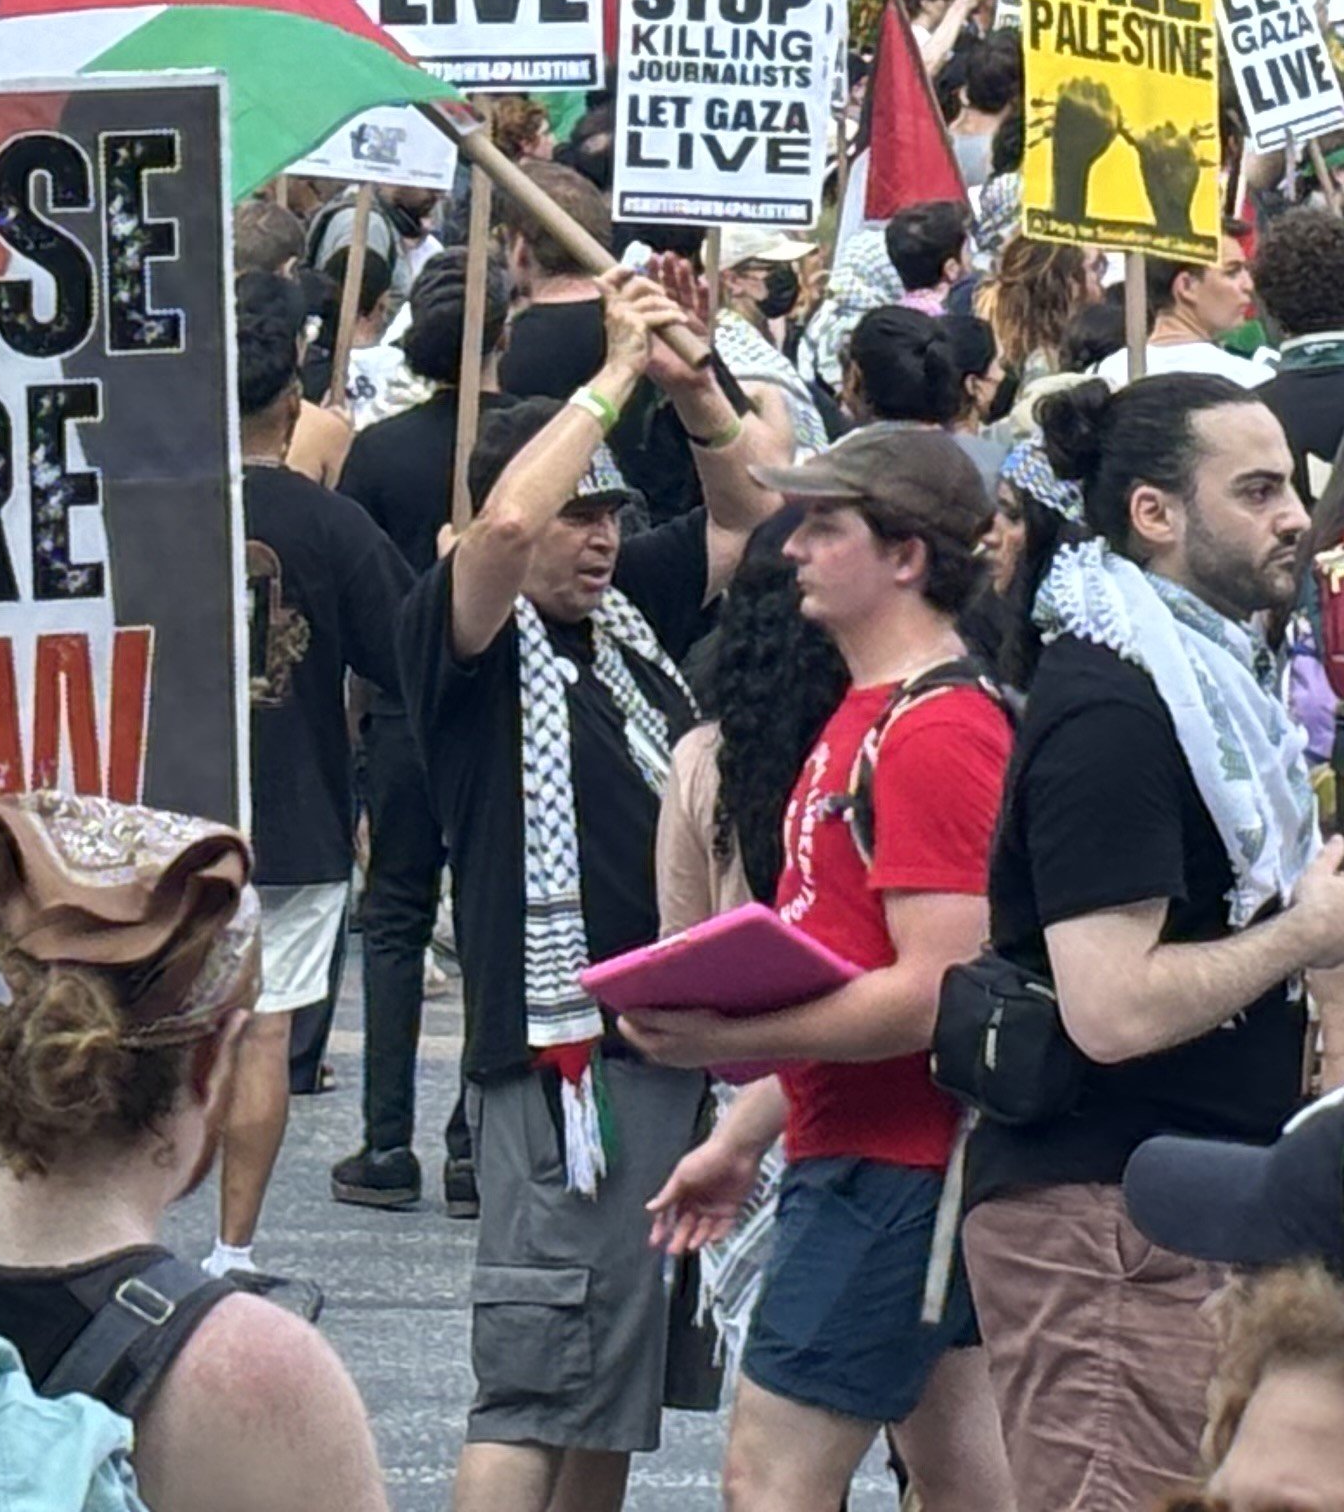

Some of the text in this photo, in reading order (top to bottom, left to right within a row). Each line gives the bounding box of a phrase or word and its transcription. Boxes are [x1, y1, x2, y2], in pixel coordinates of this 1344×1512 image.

[630, 24, 813, 63] KILLING
[1231, 6, 1315, 55] GAZA
[628, 59, 812, 88] JOURNALISTS
[1242, 43, 1334, 114] LIVE
[627, 94, 810, 133] LET GAZA
[626, 131, 811, 175] LIVE
